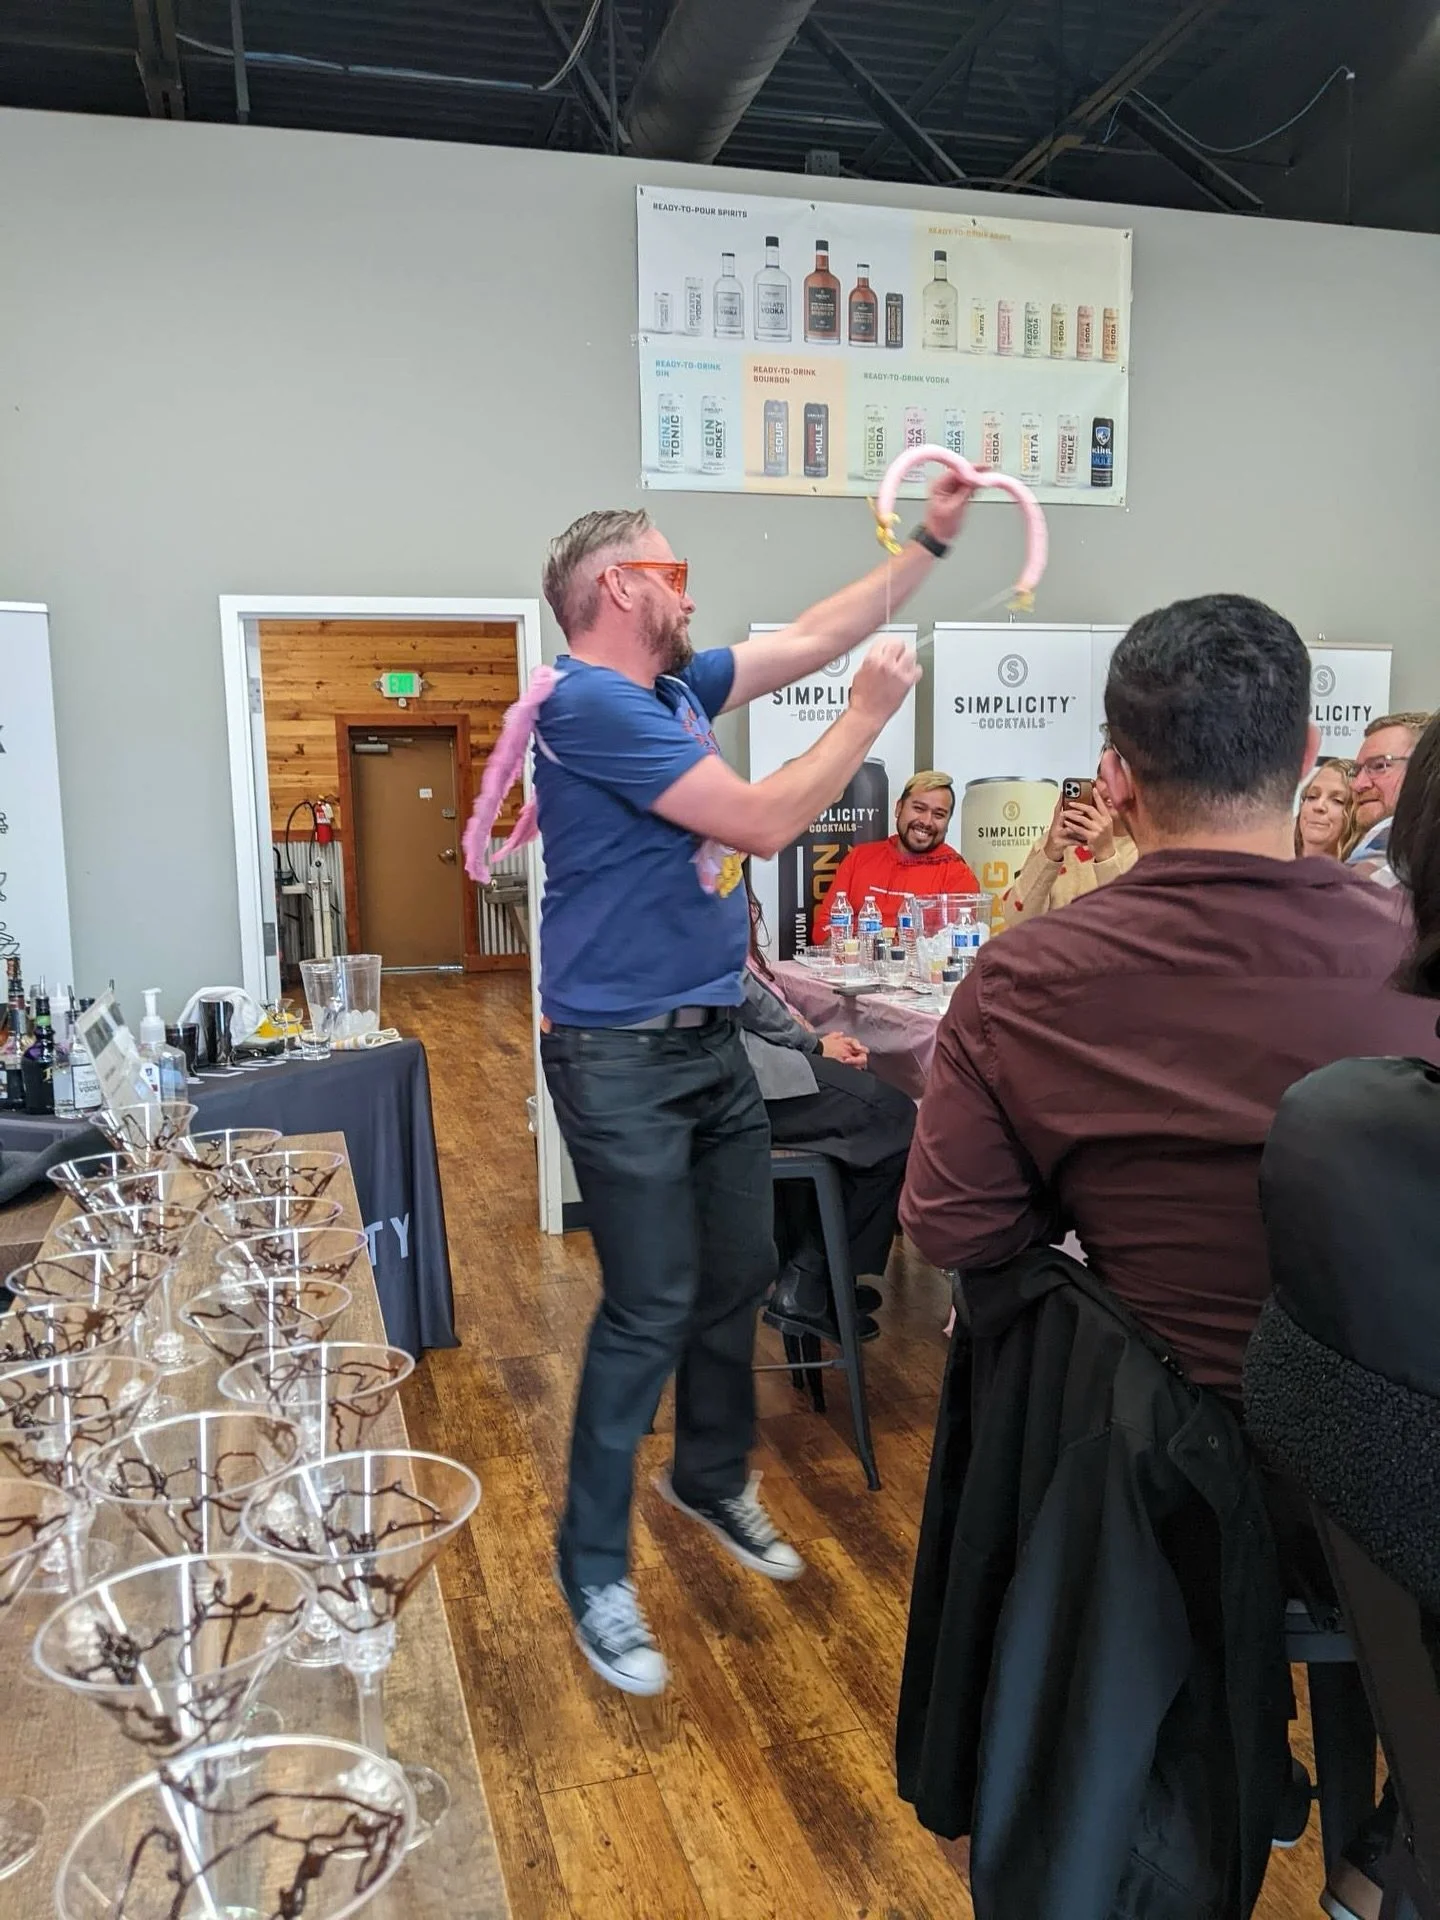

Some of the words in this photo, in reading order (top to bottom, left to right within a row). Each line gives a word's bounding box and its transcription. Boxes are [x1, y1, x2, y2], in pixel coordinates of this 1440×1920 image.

[652, 202, 716, 215] READY-TO-POUR
[717, 208, 748, 218] SPIRITS
[761, 307, 784, 315] VODKA
[930, 318, 950, 326] ARITA
[655, 359, 722, 371] READY-TO-DRINK
[753, 365, 817, 376] READY-TO-DRINK
[753, 375, 790, 384] BOURBON
[925, 376, 950, 384] VODKA
[671, 414, 680, 458] TONIC
[705, 419, 715, 446] GIN
[715, 420, 723, 458] RICKEY
[775, 422, 783, 453] SOUR
[815, 423, 823, 455] MULE
[876, 426, 884, 457] SODA
[992, 432, 1000, 462] SODA
[1031, 433, 1039, 462] RITA
[1067, 434, 1075, 464] MULE
[772, 686, 851, 705] SIMPLI
[798, 709, 842, 722] COCKT
[1315, 705, 1372, 722] LICITY
[978, 717, 1046, 729] COCKTAILS
[818, 808, 875, 822] PLICITY
[978, 826, 1046, 838] SIMPLICITY
[795, 913, 807, 956] EMIUM
